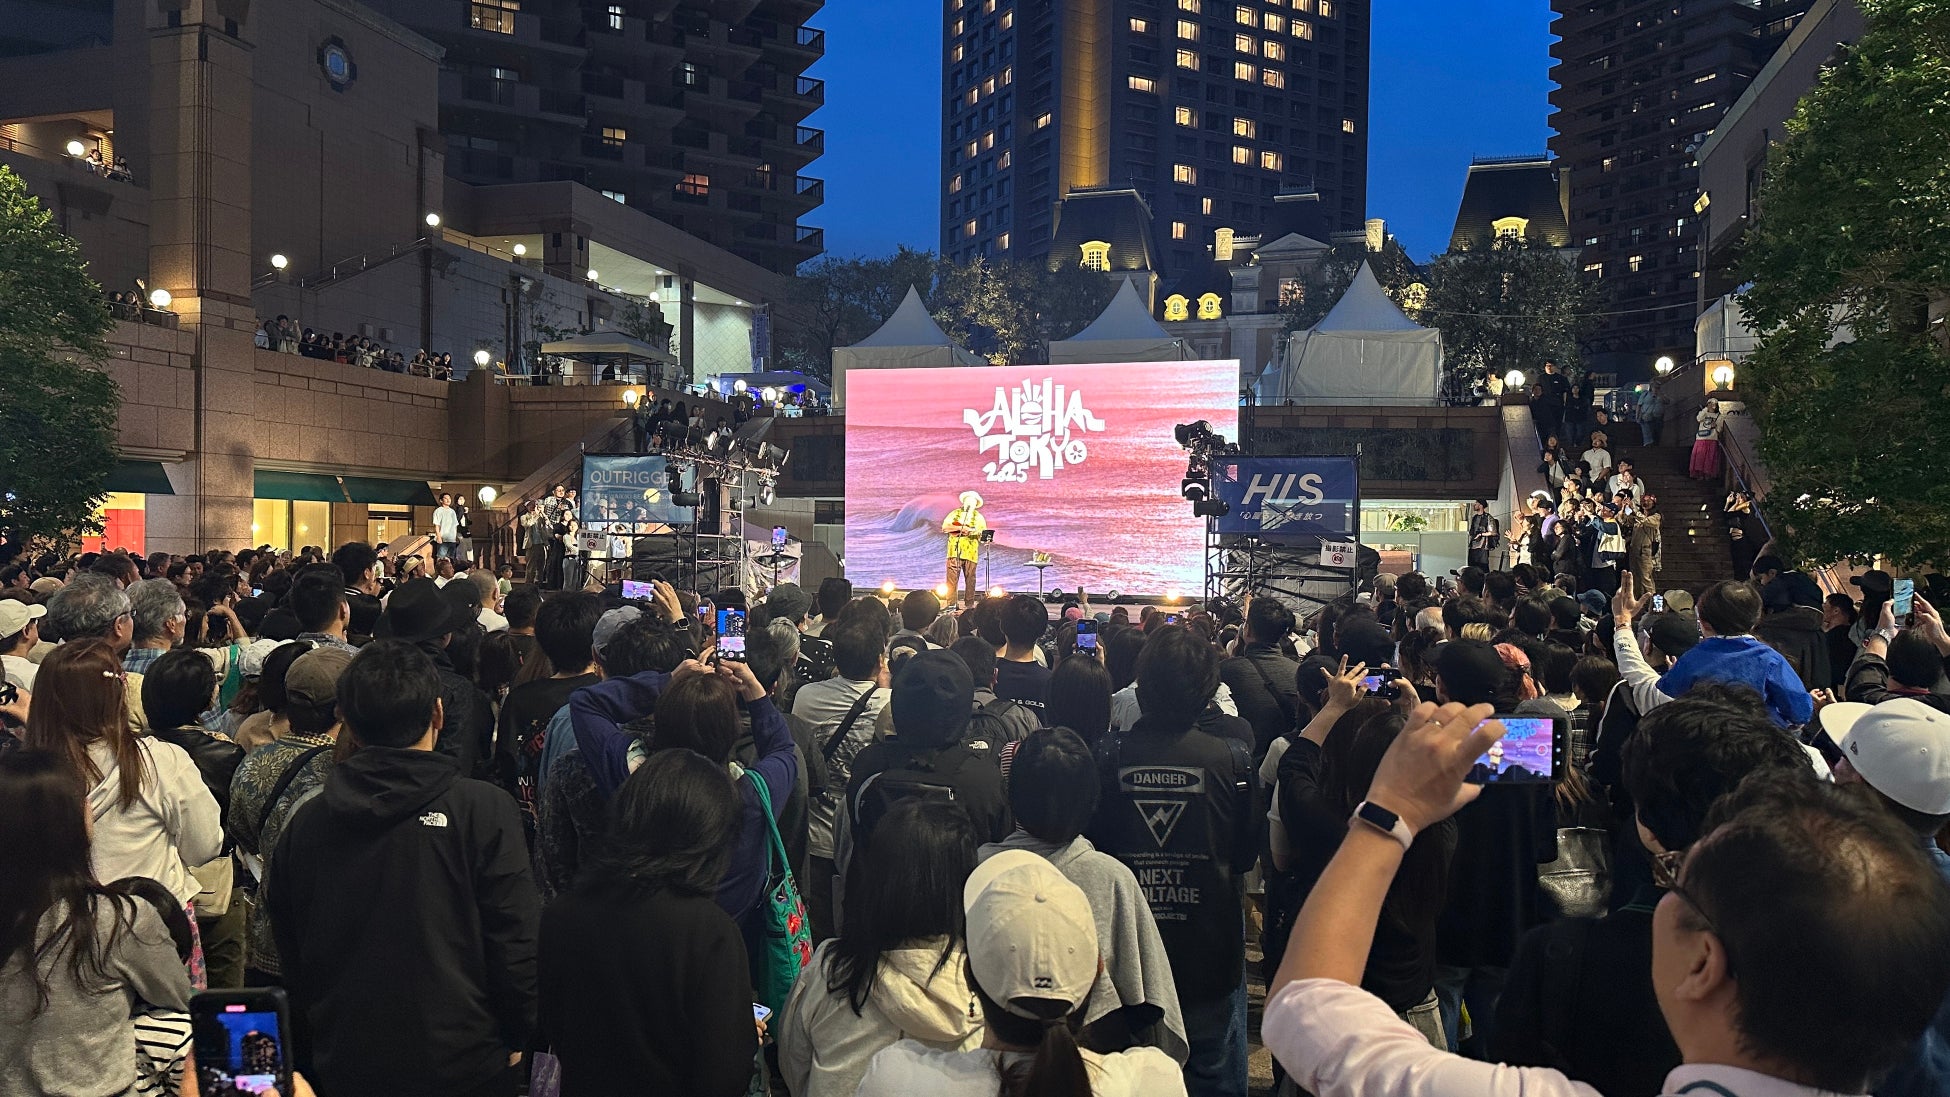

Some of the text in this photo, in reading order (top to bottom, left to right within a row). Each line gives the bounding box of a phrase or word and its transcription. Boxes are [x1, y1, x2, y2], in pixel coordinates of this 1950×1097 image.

[963, 377, 1105, 437] ALOHA
[979, 427, 1087, 479] TOKYO
[982, 461, 1030, 483] 2025
[1241, 473, 1324, 506] HIS
[1133, 773, 1187, 785] DANGER
[1140, 869, 1184, 885] NEXT
[1141, 886, 1200, 904] OLTAGE
